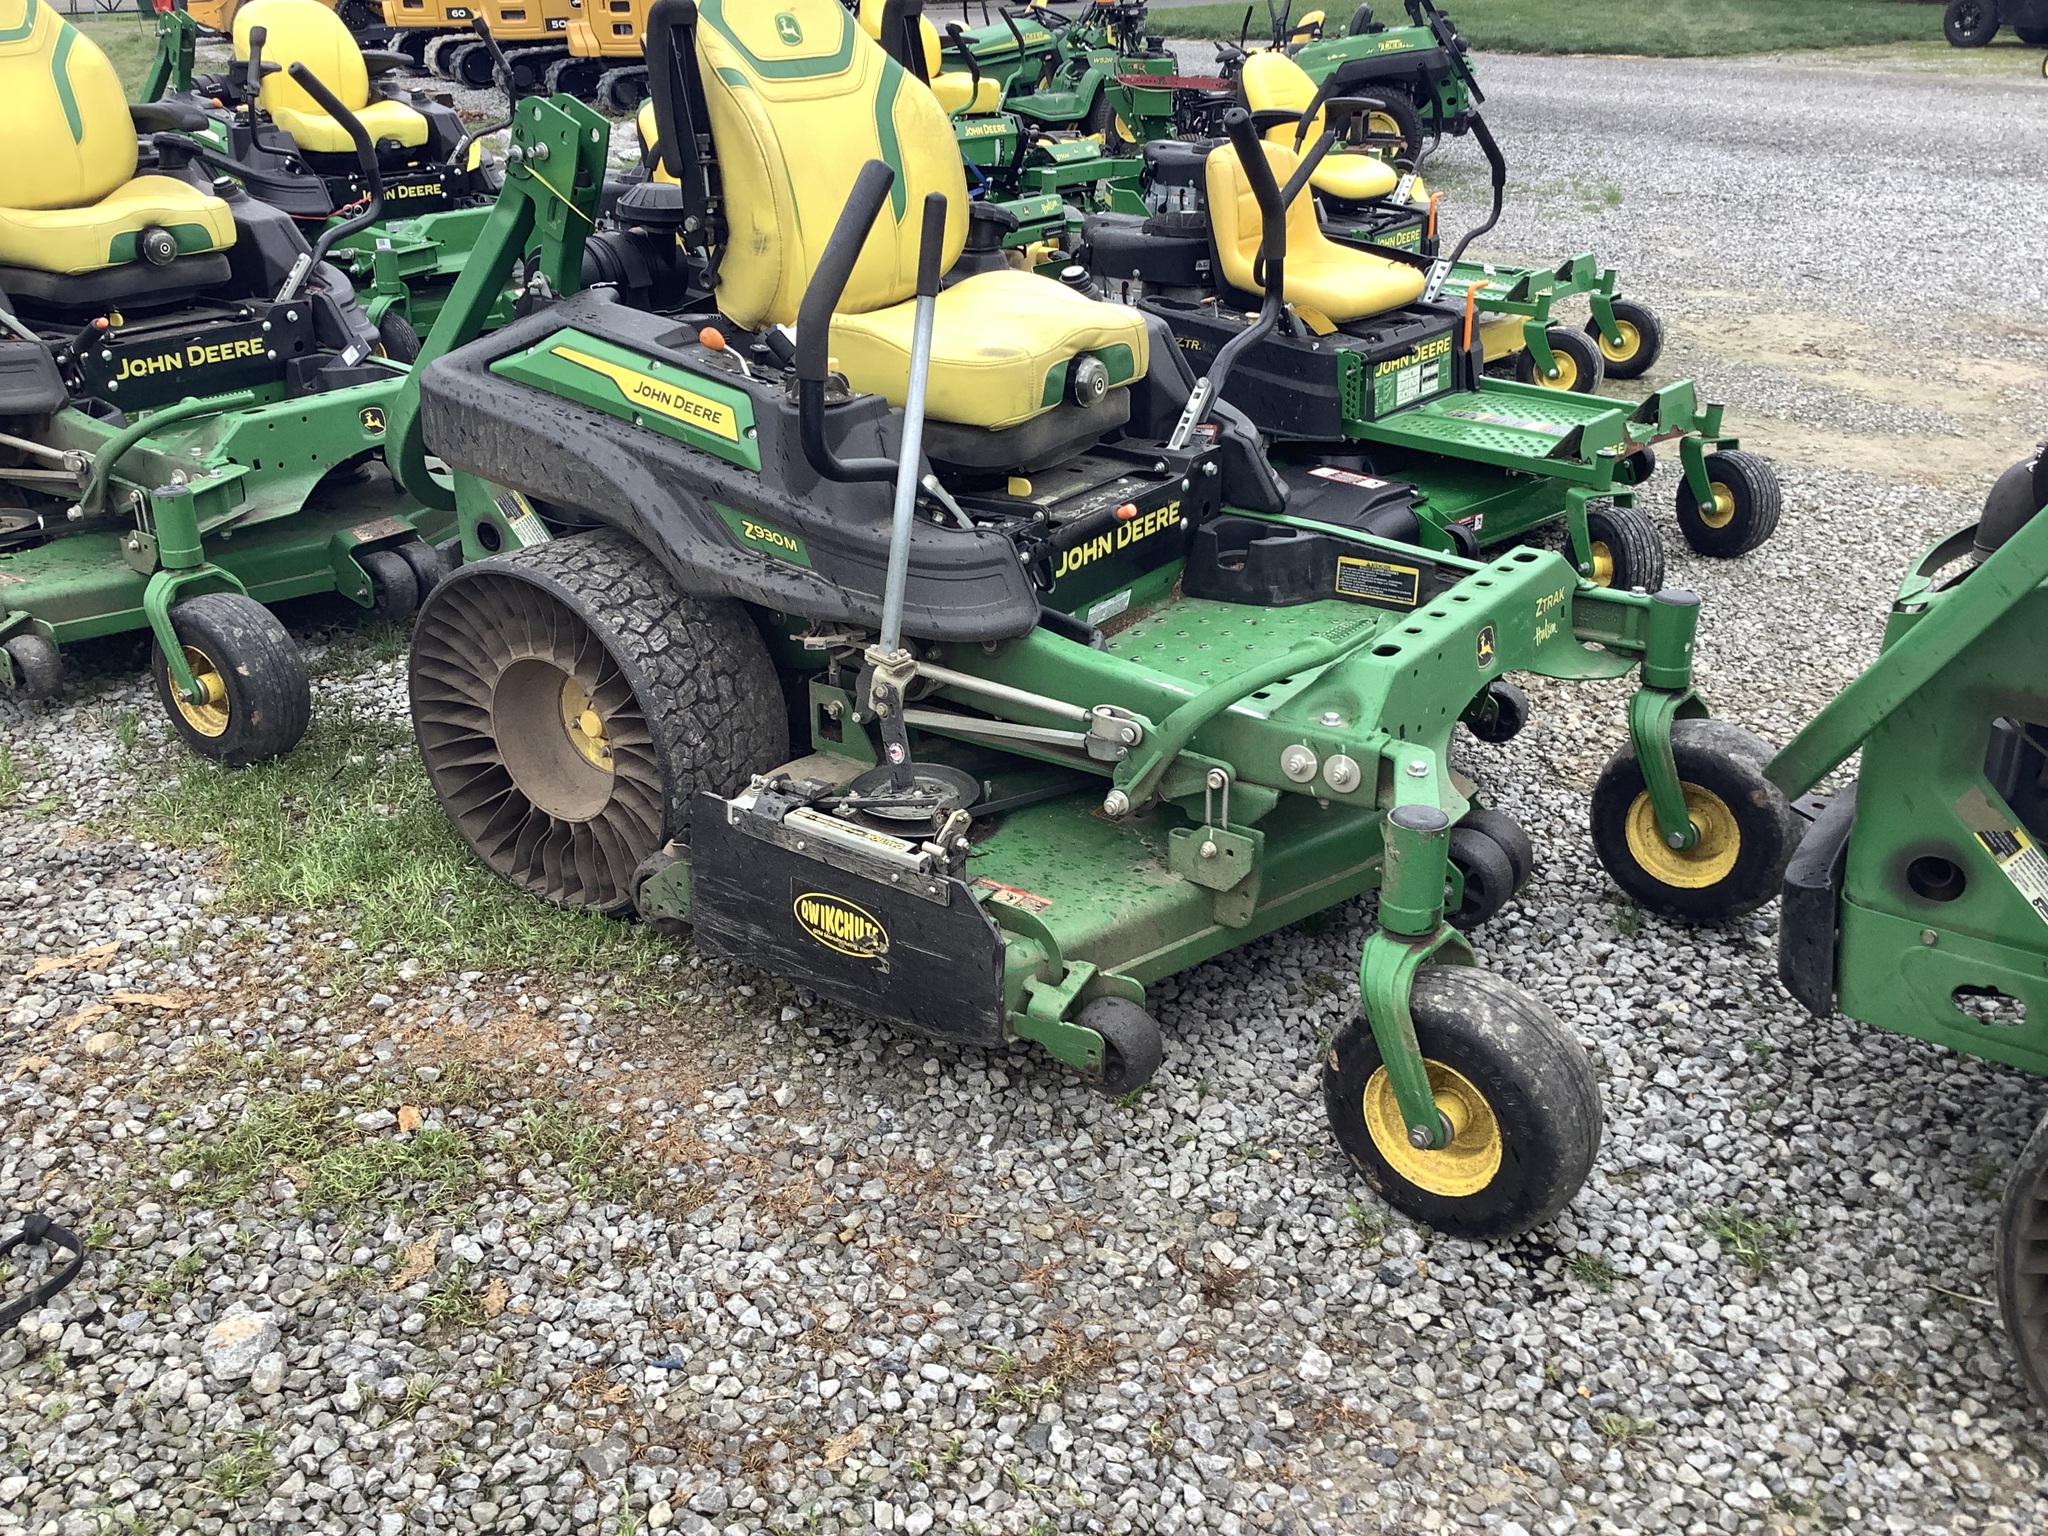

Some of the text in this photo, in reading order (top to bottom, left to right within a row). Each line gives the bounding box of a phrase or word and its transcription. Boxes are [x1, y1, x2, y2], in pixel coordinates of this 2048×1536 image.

[451, 9, 466, 18] 60
[965, 123, 1007, 137] JOHN DEERE
[397, 183, 442, 199] DEERE
[1396, 228, 1421, 246] DEERE
[116, 337, 265, 381] JOHN DEERE
[1375, 336, 1451, 378] JOHN DEERE
[633, 381, 722, 424] JOHN DEERE
[741, 520, 798, 553] Z930M
[1055, 500, 1180, 579] JOHN DEERE
[1535, 585, 1566, 618] ZTRAK
